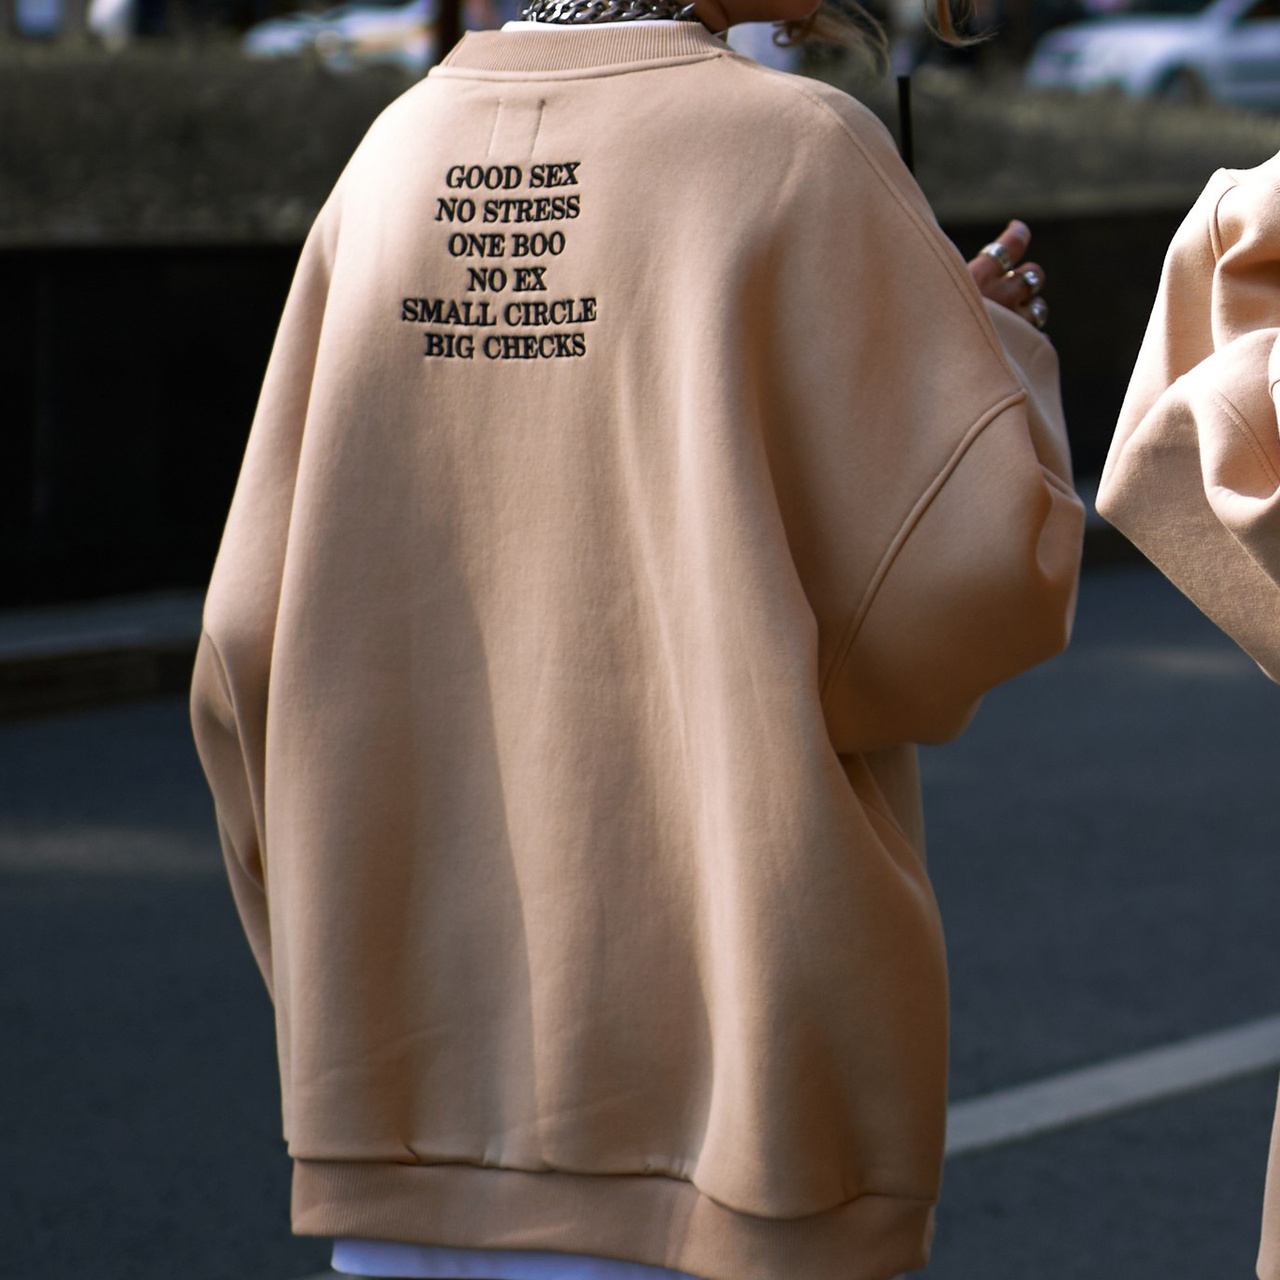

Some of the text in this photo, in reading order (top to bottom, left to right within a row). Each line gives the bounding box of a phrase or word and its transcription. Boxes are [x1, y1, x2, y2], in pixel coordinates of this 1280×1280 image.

[446, 161, 581, 190] GOOD SEX
[435, 194, 580, 223] NO STRESS
[448, 230, 565, 258] ONE BOO
[466, 266, 547, 292] NO EX
[401, 296, 596, 327] SMALL CIRCLE
[423, 332, 586, 360] BIG CHECKS
